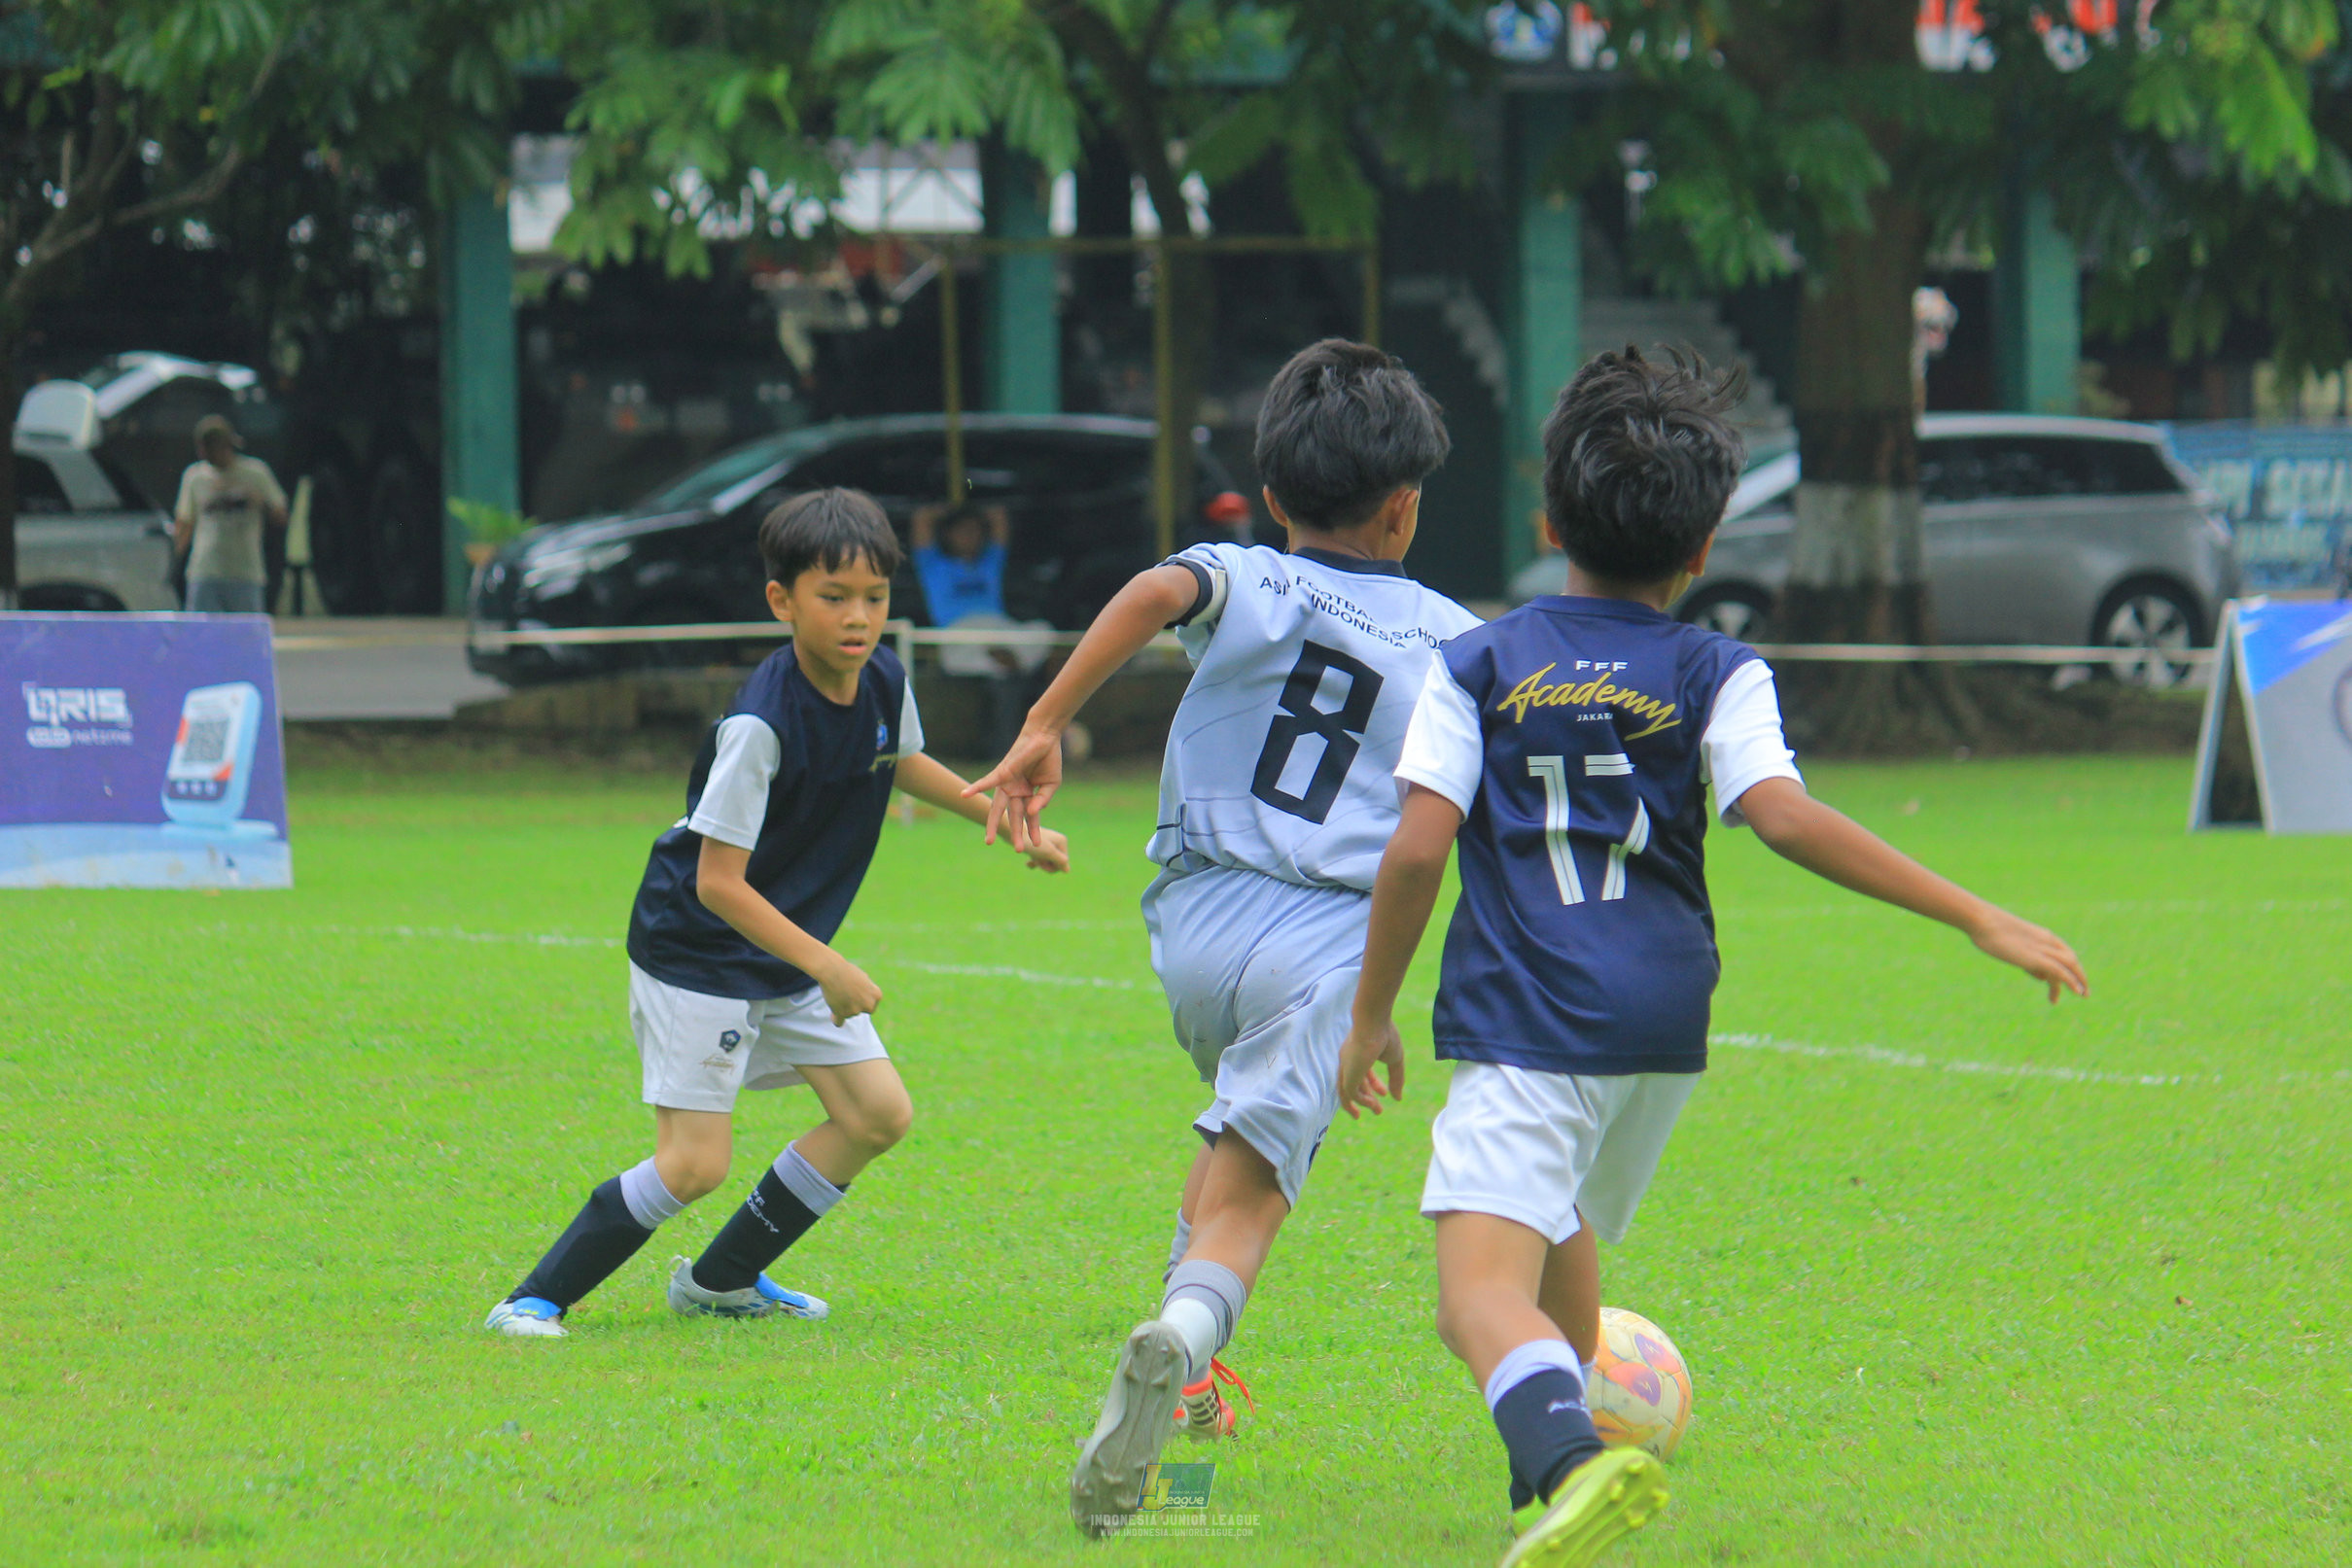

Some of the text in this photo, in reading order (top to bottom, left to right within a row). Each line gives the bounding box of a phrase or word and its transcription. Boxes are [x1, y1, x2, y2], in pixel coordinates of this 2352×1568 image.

[1310, 593, 1408, 649] INDONESIA
[1391, 627, 1449, 649] SCHO
[1575, 659, 1629, 672] FFF
[1250, 639, 1386, 825] 8
[1495, 661, 1683, 742] Academy
[1526, 752, 1651, 906] 17
